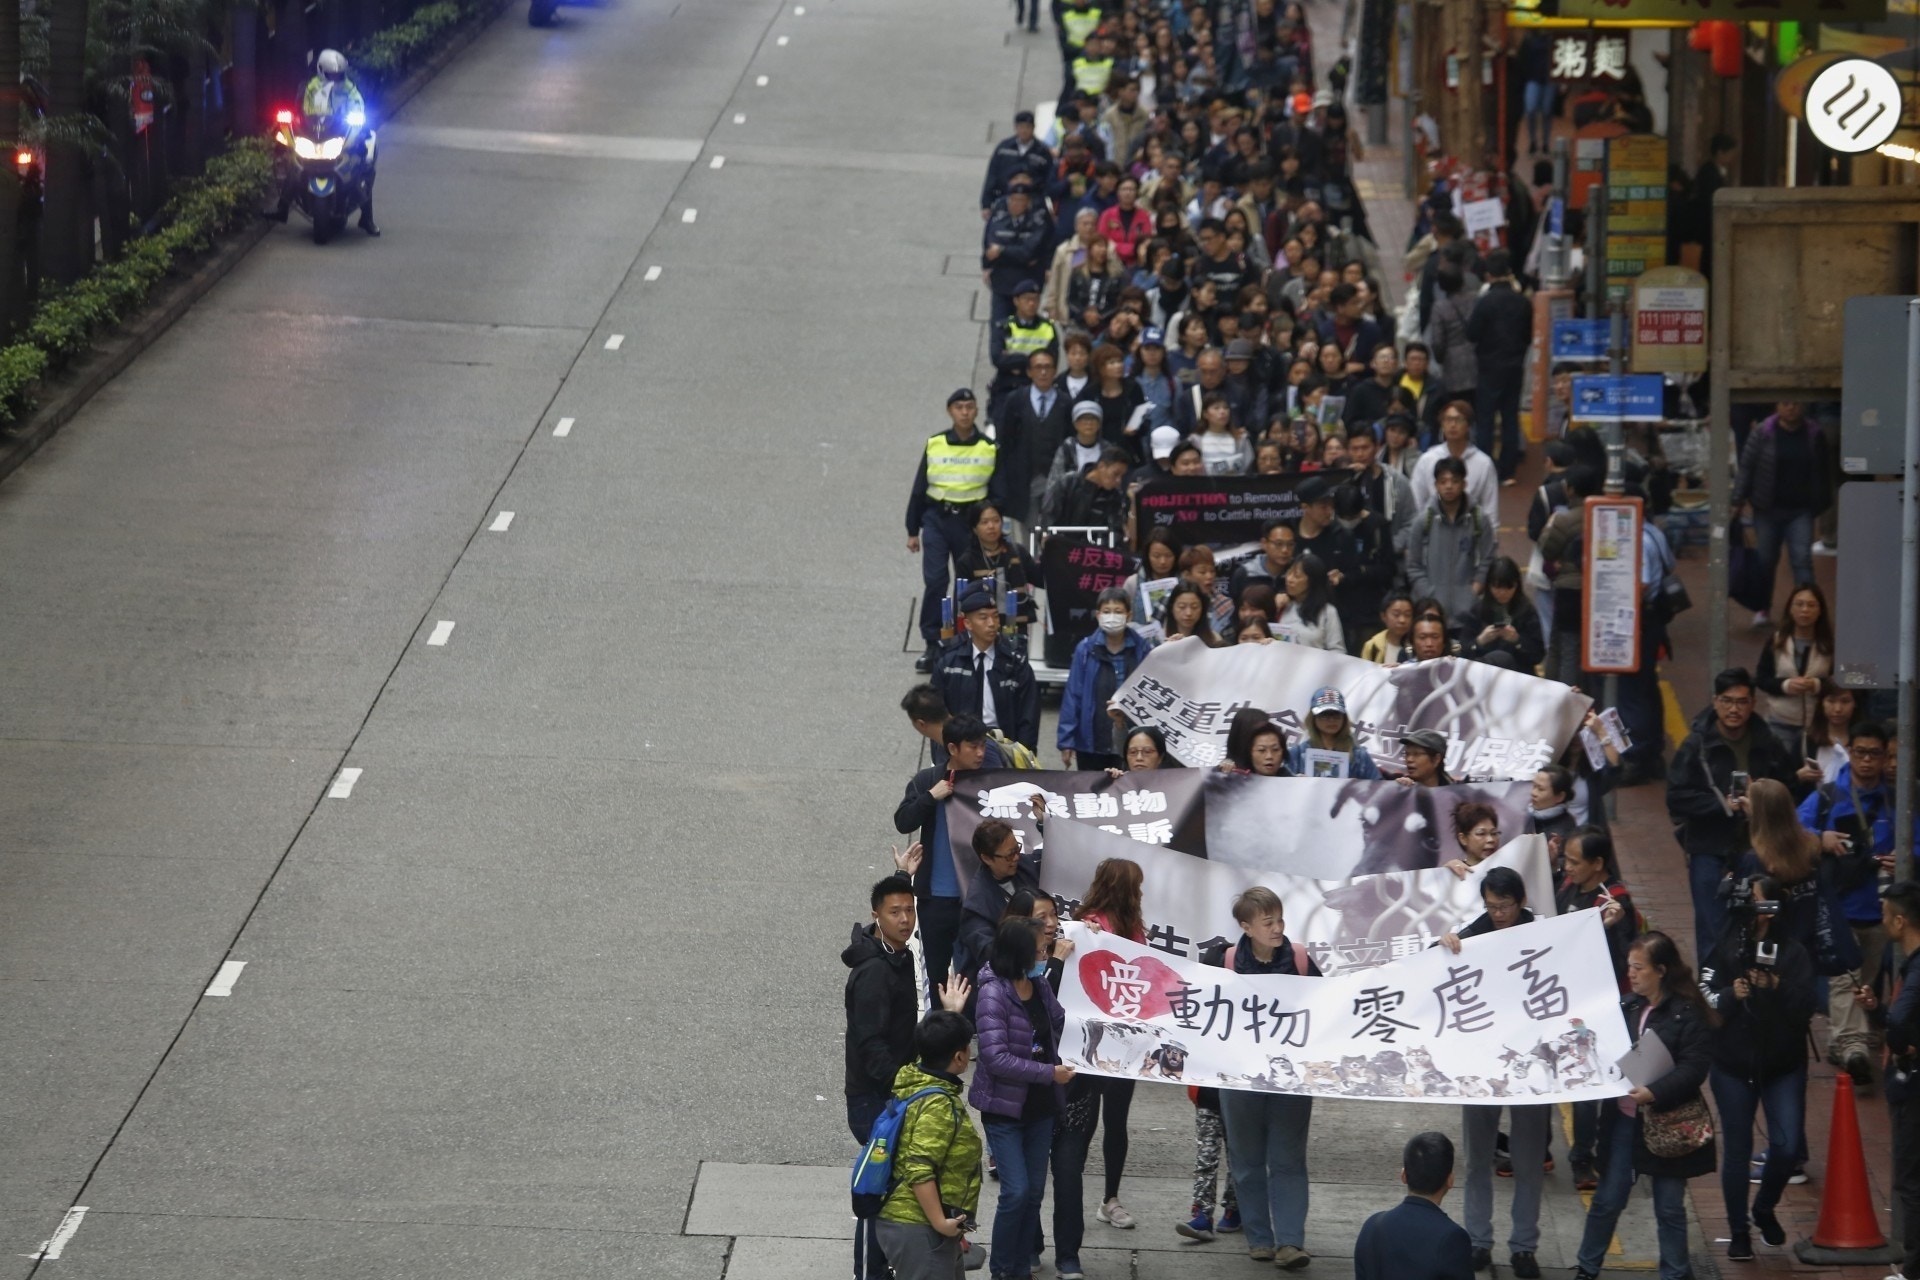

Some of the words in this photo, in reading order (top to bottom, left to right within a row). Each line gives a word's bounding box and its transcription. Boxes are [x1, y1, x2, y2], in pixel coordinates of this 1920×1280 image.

[1551, 36, 1628, 79] 粥麵
[1640, 312, 1658, 325] 111
[1230, 493, 1241, 503] to
[1244, 491, 1293, 503] Removal
[1154, 511, 1175, 525] Say
[1204, 511, 1216, 521] to
[1218, 508, 1250, 521] Cattle
[1100, 960, 1311, 1047] 愛動物
[1352, 945, 1570, 1044] 零虐畜
